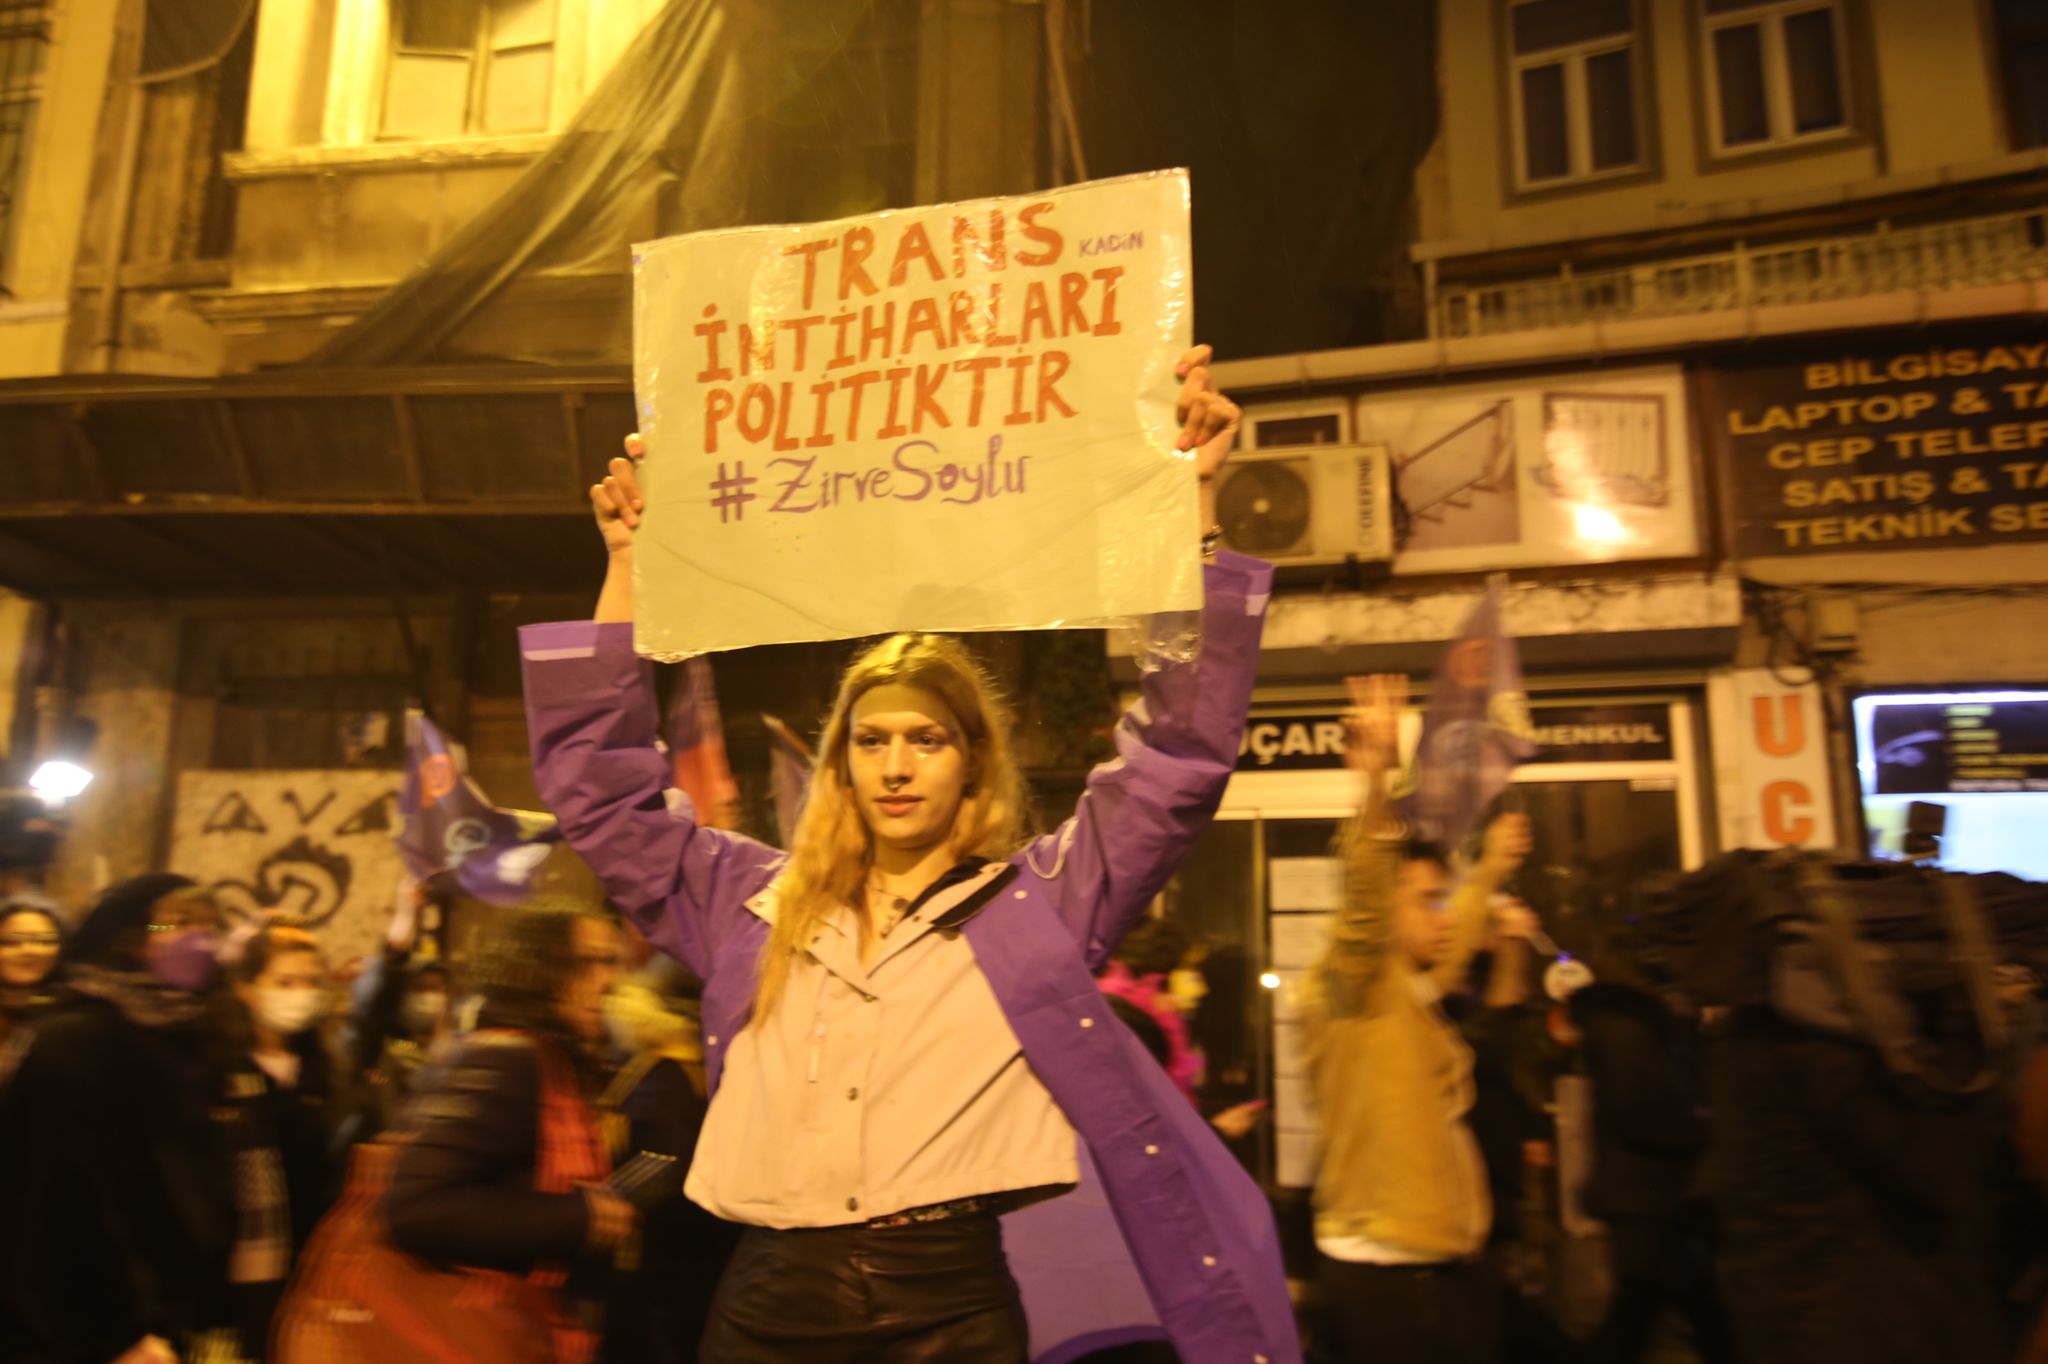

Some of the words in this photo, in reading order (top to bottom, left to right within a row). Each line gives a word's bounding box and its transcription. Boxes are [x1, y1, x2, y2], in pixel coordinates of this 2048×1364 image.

[781, 201, 1065, 310] TRANS
[695, 266, 1124, 384] İNTİHARLARI
[1805, 343, 2048, 390] BİLGİSAY
[704, 346, 1079, 454] POLİTİKTİR
[1728, 392, 1936, 436] LAPTOP
[1950, 387, 1990, 415] &
[1767, 436, 1875, 470] CEP
[1783, 471, 1935, 508] SATIŞ
[1950, 467, 1990, 495] &
[1775, 506, 1976, 547] TEKNİK
